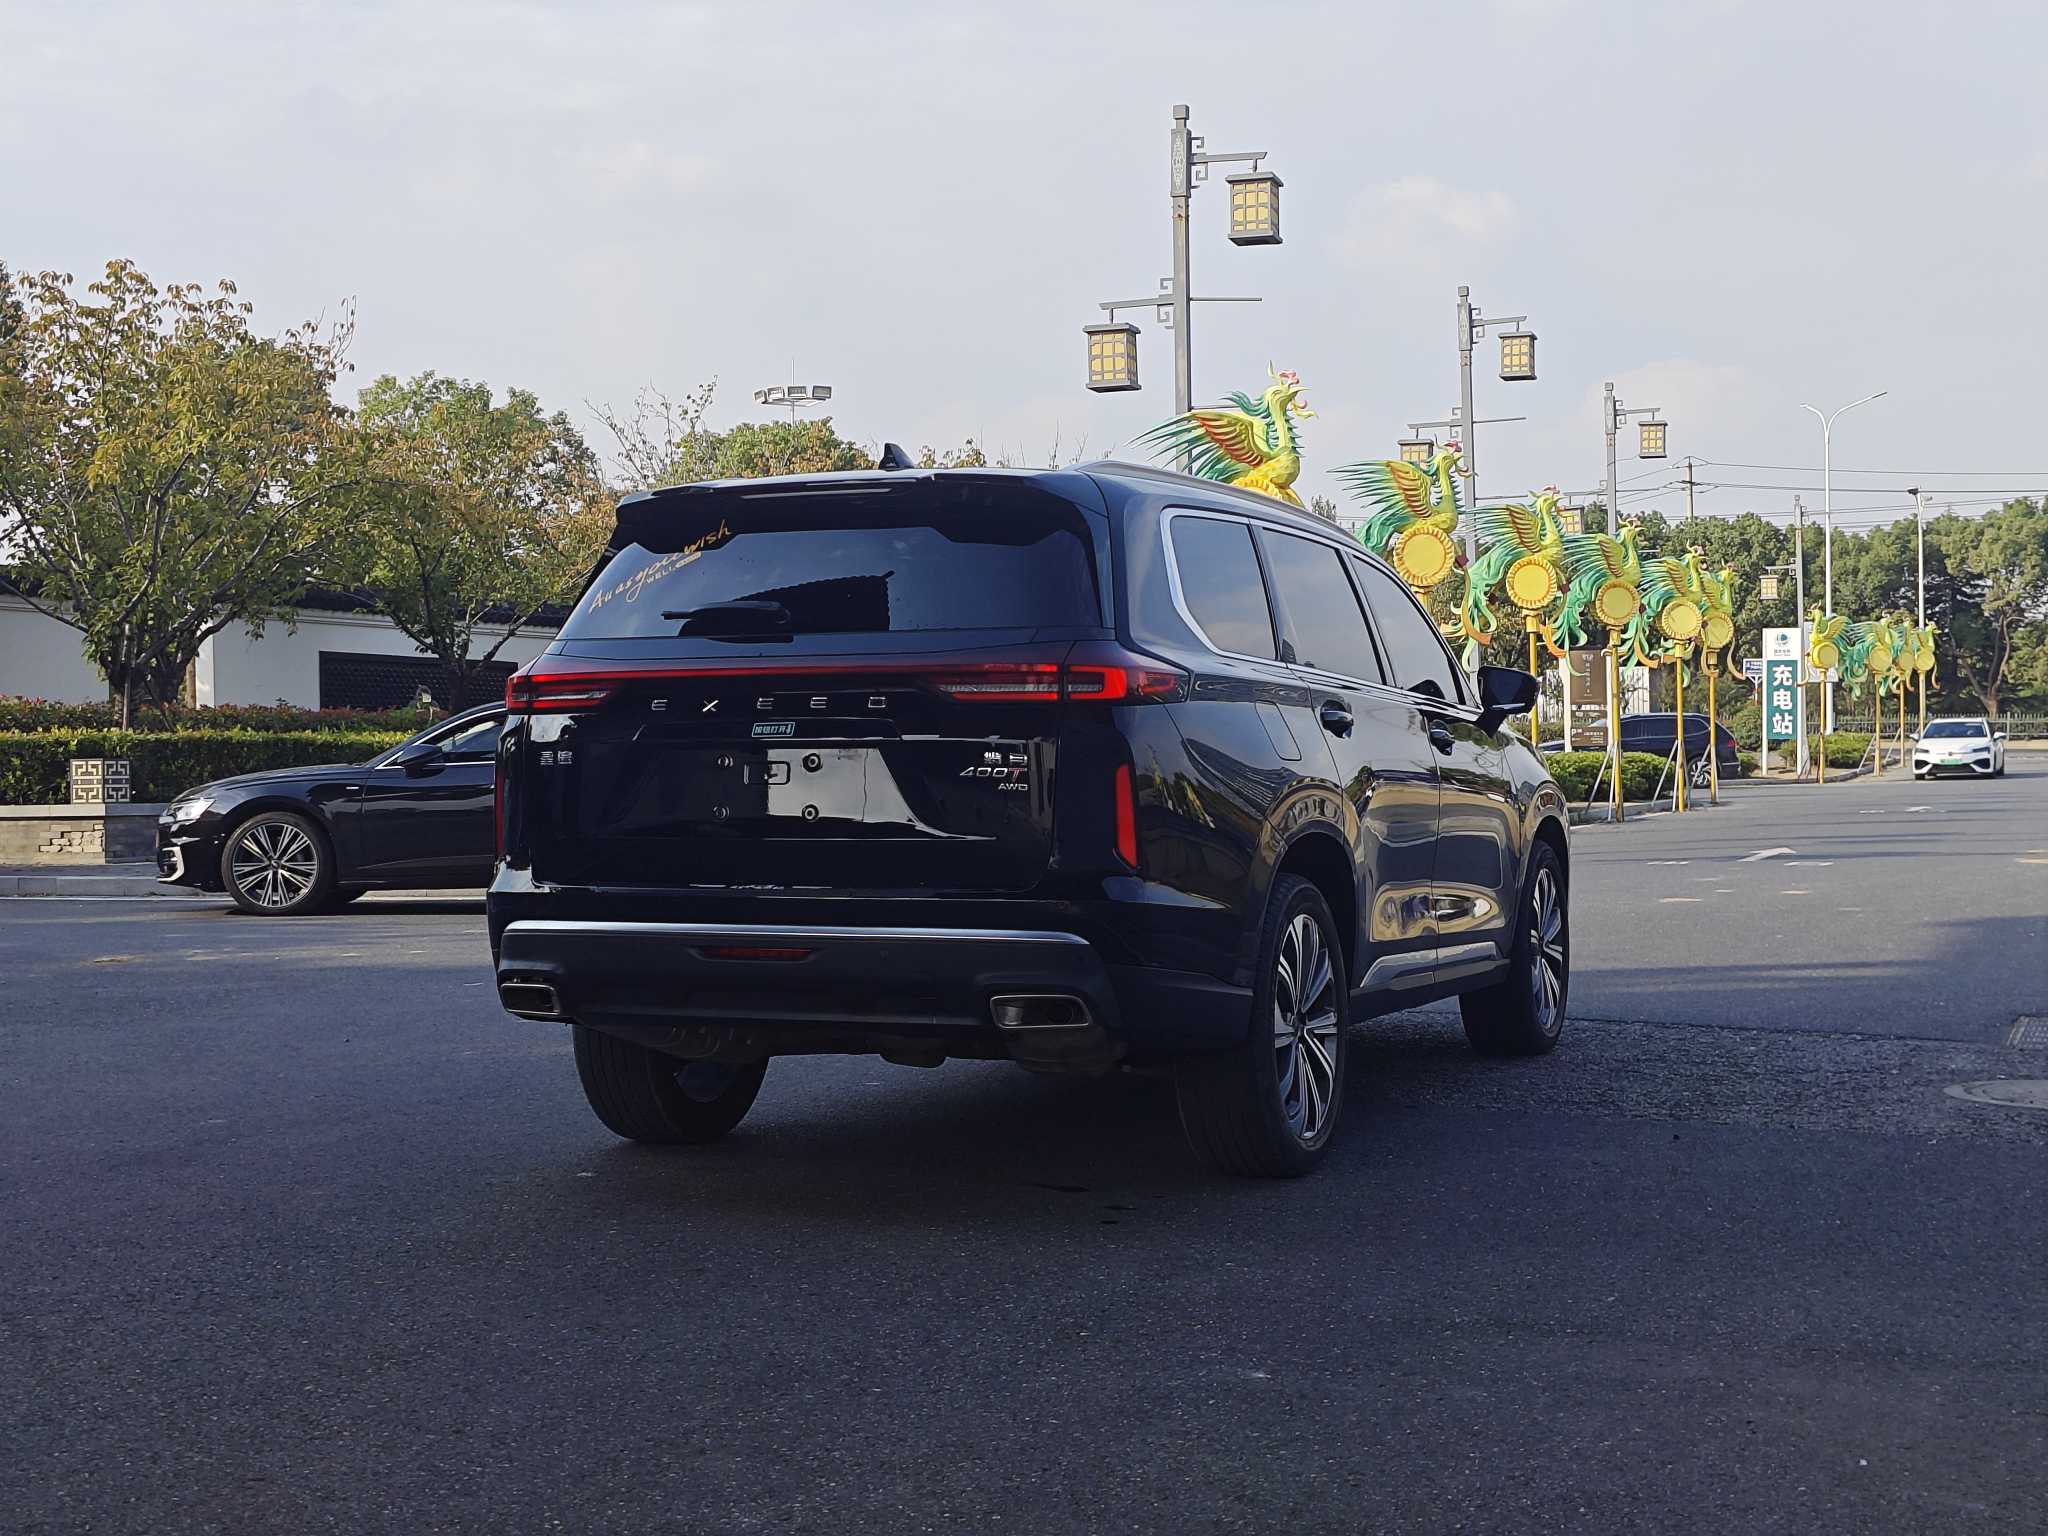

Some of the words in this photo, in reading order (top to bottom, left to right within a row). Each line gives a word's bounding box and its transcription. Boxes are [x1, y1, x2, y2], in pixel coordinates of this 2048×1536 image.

[683, 519, 731, 554] wish
[651, 696, 887, 712] EXEED
[1772, 664, 1793, 734] 充电站
[959, 767, 1028, 784] 400T
[998, 783, 1029, 792] AWD
